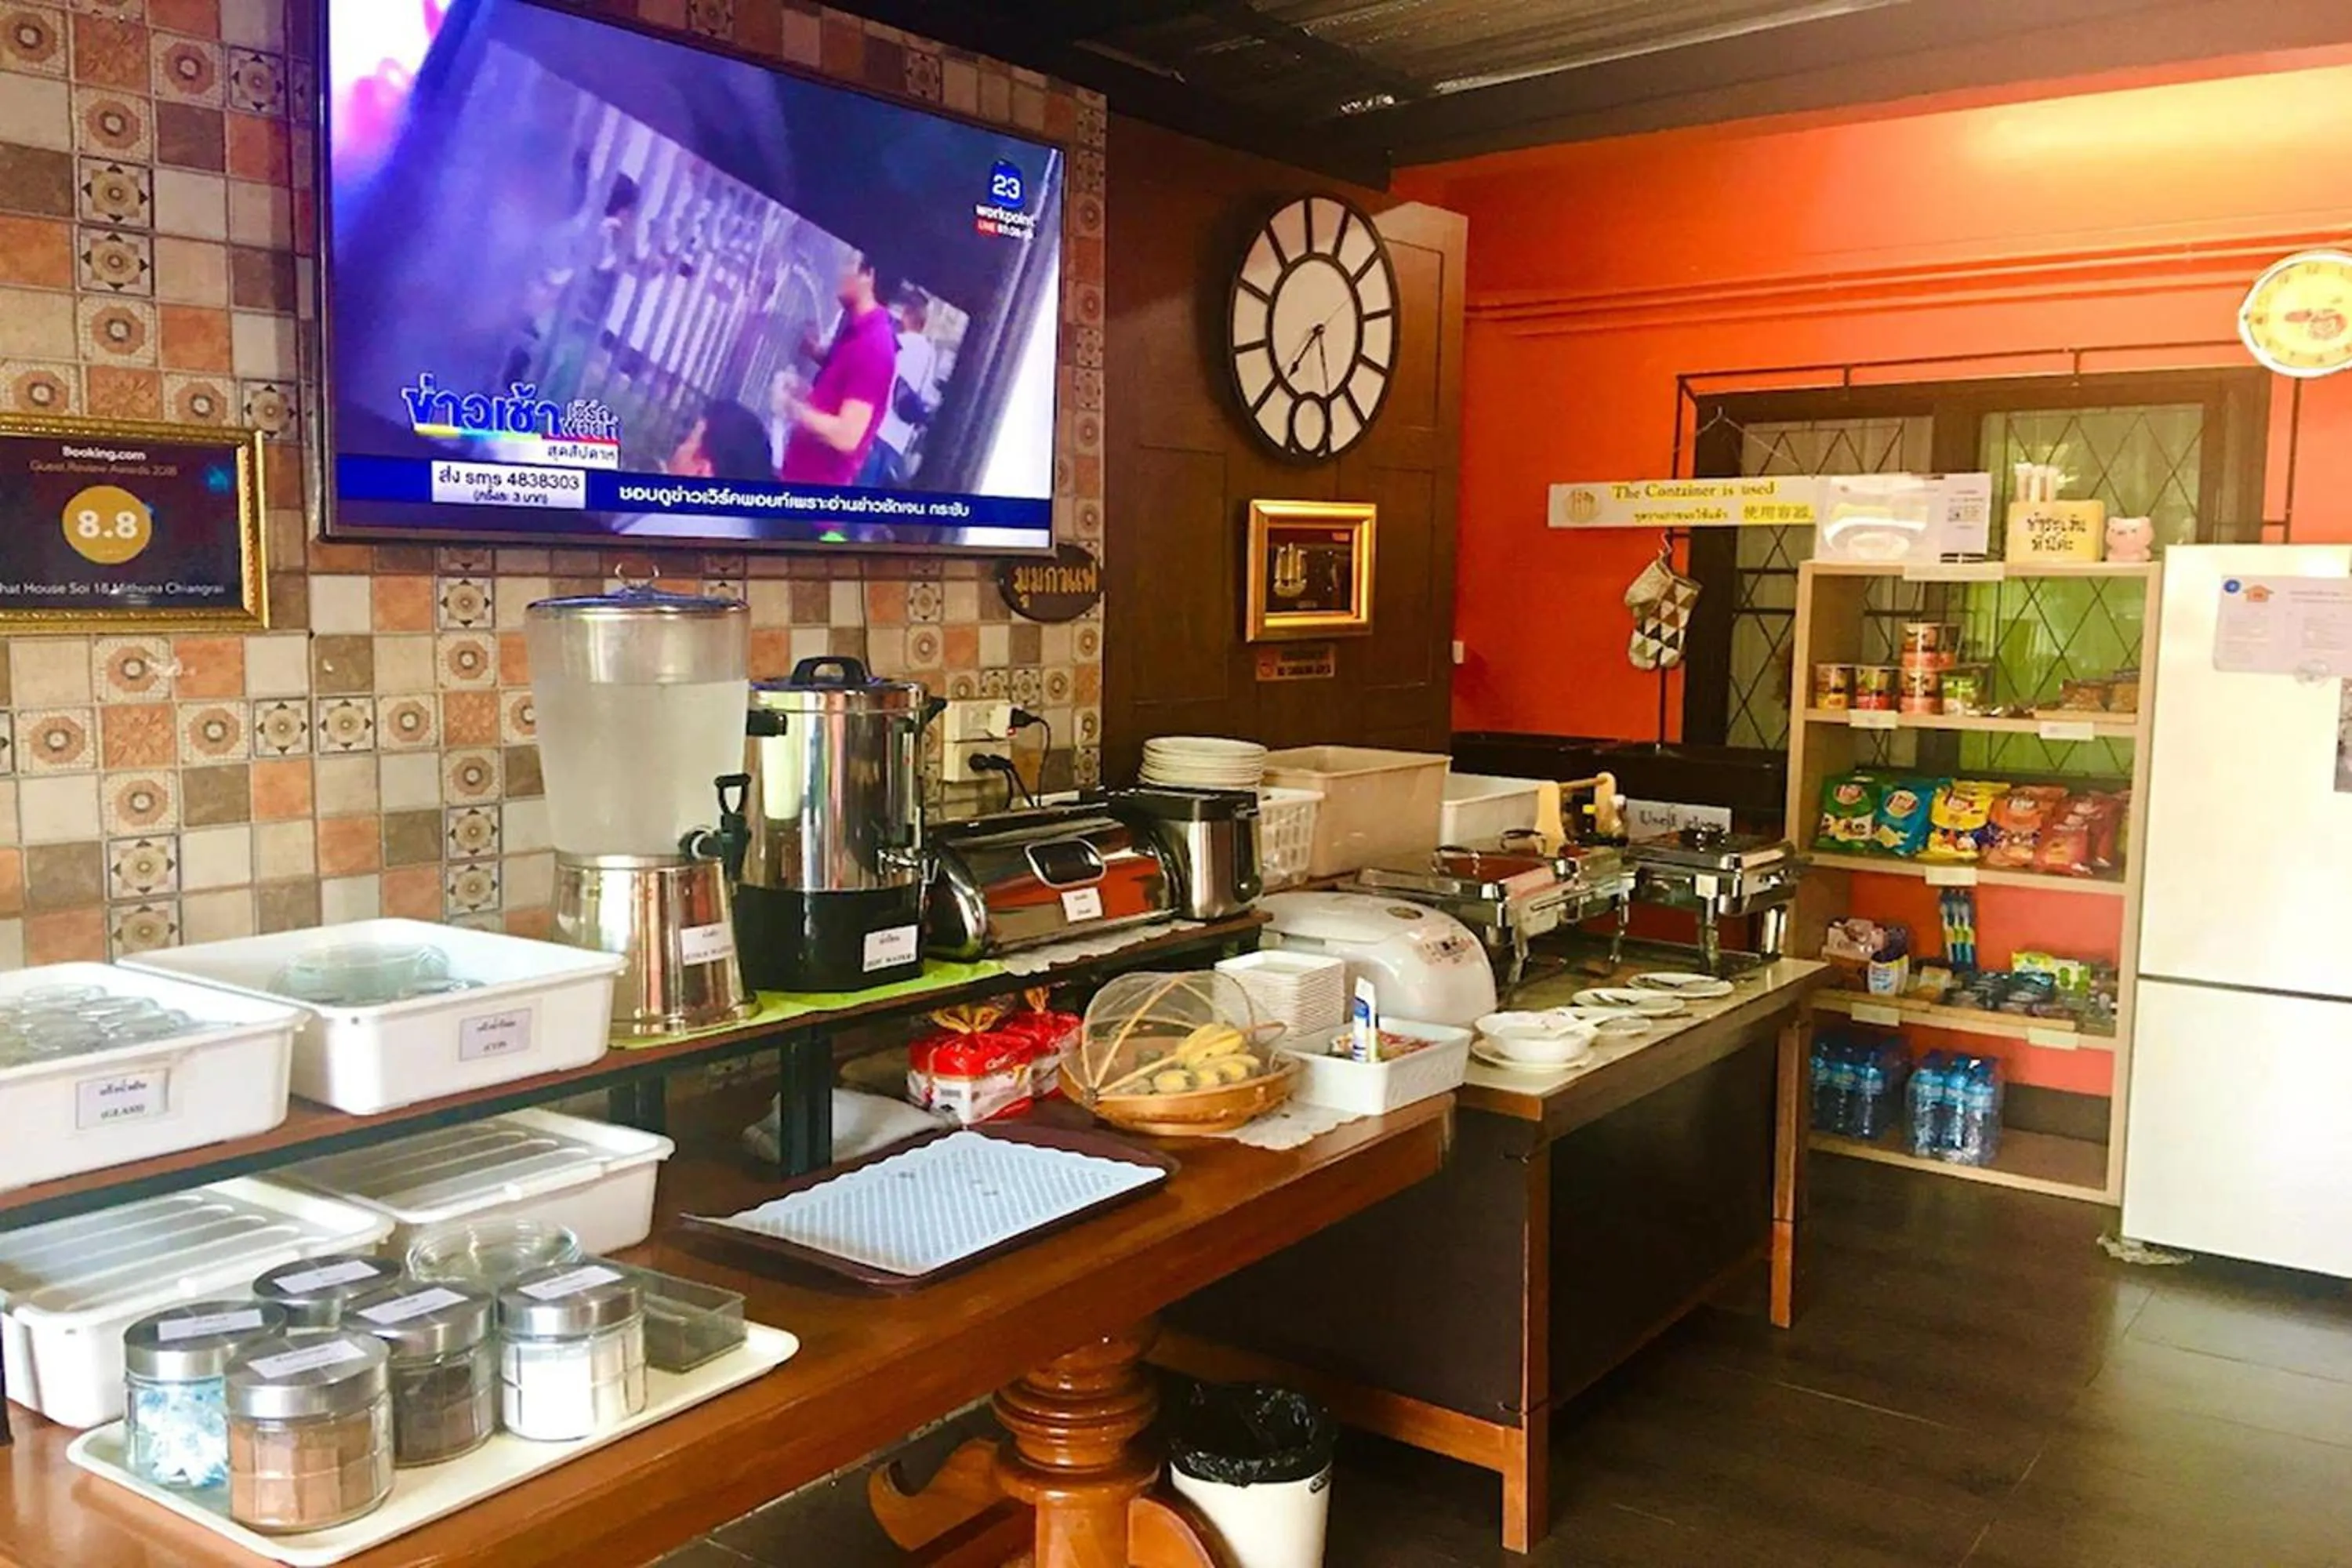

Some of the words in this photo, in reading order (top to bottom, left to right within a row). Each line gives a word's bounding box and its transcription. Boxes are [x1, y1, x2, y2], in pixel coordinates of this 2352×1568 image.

[992, 173, 1021, 199] 23
[401, 372, 562, 436] ข่าวเช้า
[62, 445, 147, 462] Booking.com
[506, 472, 580, 490] 4838303
[1612, 485, 1640, 499] The
[1645, 484, 1718, 499] Container
[1722, 483, 1734, 496] is
[1740, 481, 1776, 496] used
[78, 510, 138, 539] 8.8
[23, 583, 67, 594] House
[68, 582, 91, 594] Soi
